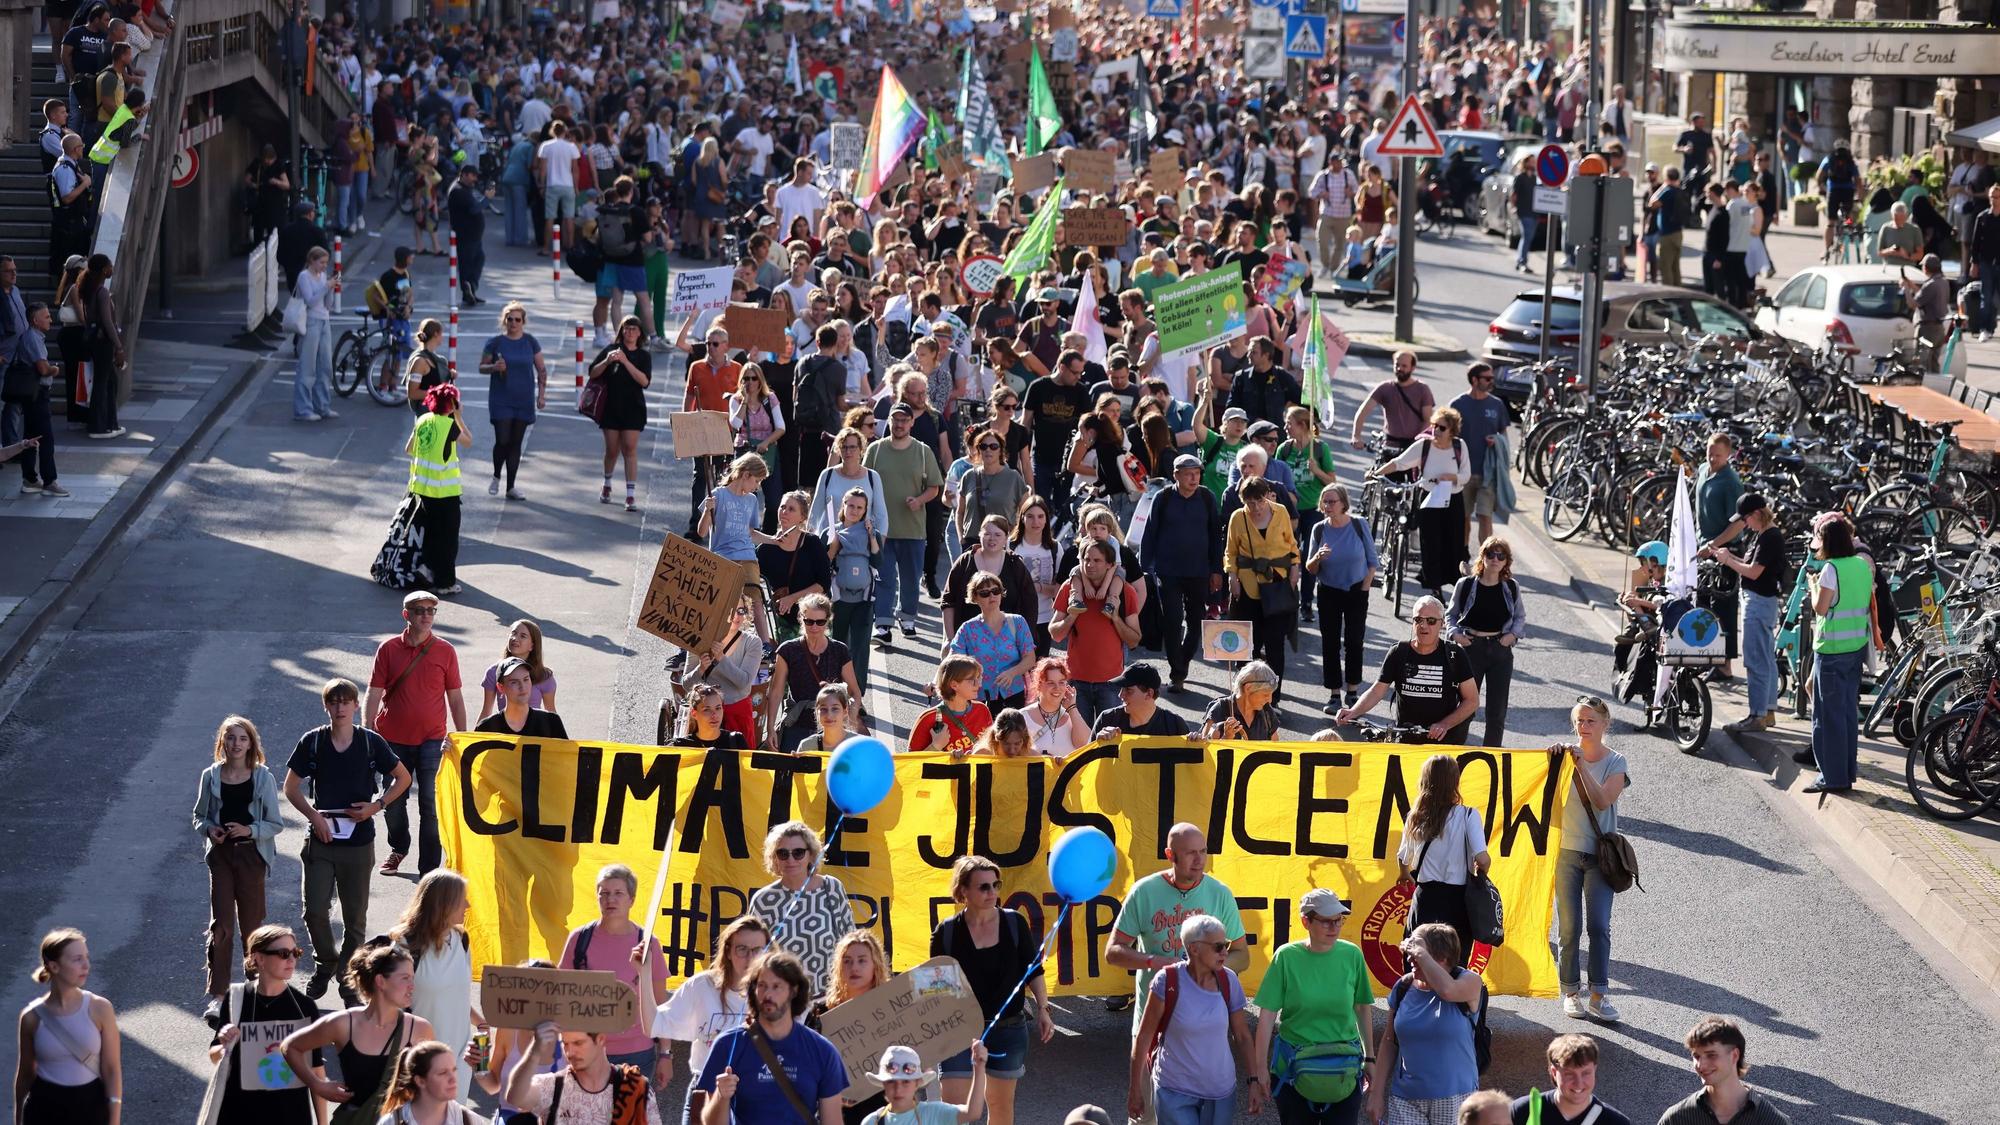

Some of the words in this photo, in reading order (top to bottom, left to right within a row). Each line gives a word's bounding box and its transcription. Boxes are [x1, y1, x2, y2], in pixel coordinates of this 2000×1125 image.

[1771, 39, 1844, 62] Excelsior
[1852, 39, 1905, 63] Hotel
[1913, 41, 1956, 63] Ernst
[834, 127, 860, 137] CHANGE
[832, 149, 846, 157] NOT
[850, 149, 860, 157] THE
[833, 159, 859, 169] CLIMATE
[1071, 233, 1084, 241] GO
[1074, 221, 1107, 229] CLIMATE
[1159, 271, 1239, 303] Photovoltaik-Anlagen
[1160, 303, 1173, 313] auf
[1175, 297, 1194, 308] allen
[1195, 282, 1238, 302] öffentlichen
[1161, 306, 1200, 324] Gebäuden
[1172, 319, 1192, 332] Köln!
[663, 552, 685, 568] MAL
[691, 566, 715, 581] NACH
[658, 562, 720, 606] ZAHLEN
[650, 590, 710, 631] FAKTEN
[641, 609, 702, 649] HANDELN
[1401, 683, 1425, 692] TRUCK
[460, 740, 870, 867] CLIMATE
[917, 744, 1352, 869] JUSTICE
[1373, 751, 1565, 860] NOW
[1363, 890, 1406, 941] FRIDAYS
[488, 973, 543, 993] DESTROY
[544, 981, 630, 1002] PATRIARCHY
[497, 997, 529, 1015] NOT
[535, 1001, 562, 1015] THE
[569, 1001, 619, 1018] PLANET
[830, 1019, 866, 1044] THIS
[872, 1008, 886, 1022] IS
[889, 991, 915, 1013] NOT
[870, 1014, 906, 1041] MEANT
[916, 997, 941, 1016] WITH
[264, 1024, 294, 1041] WITH
[848, 1052, 881, 1079] HOT
